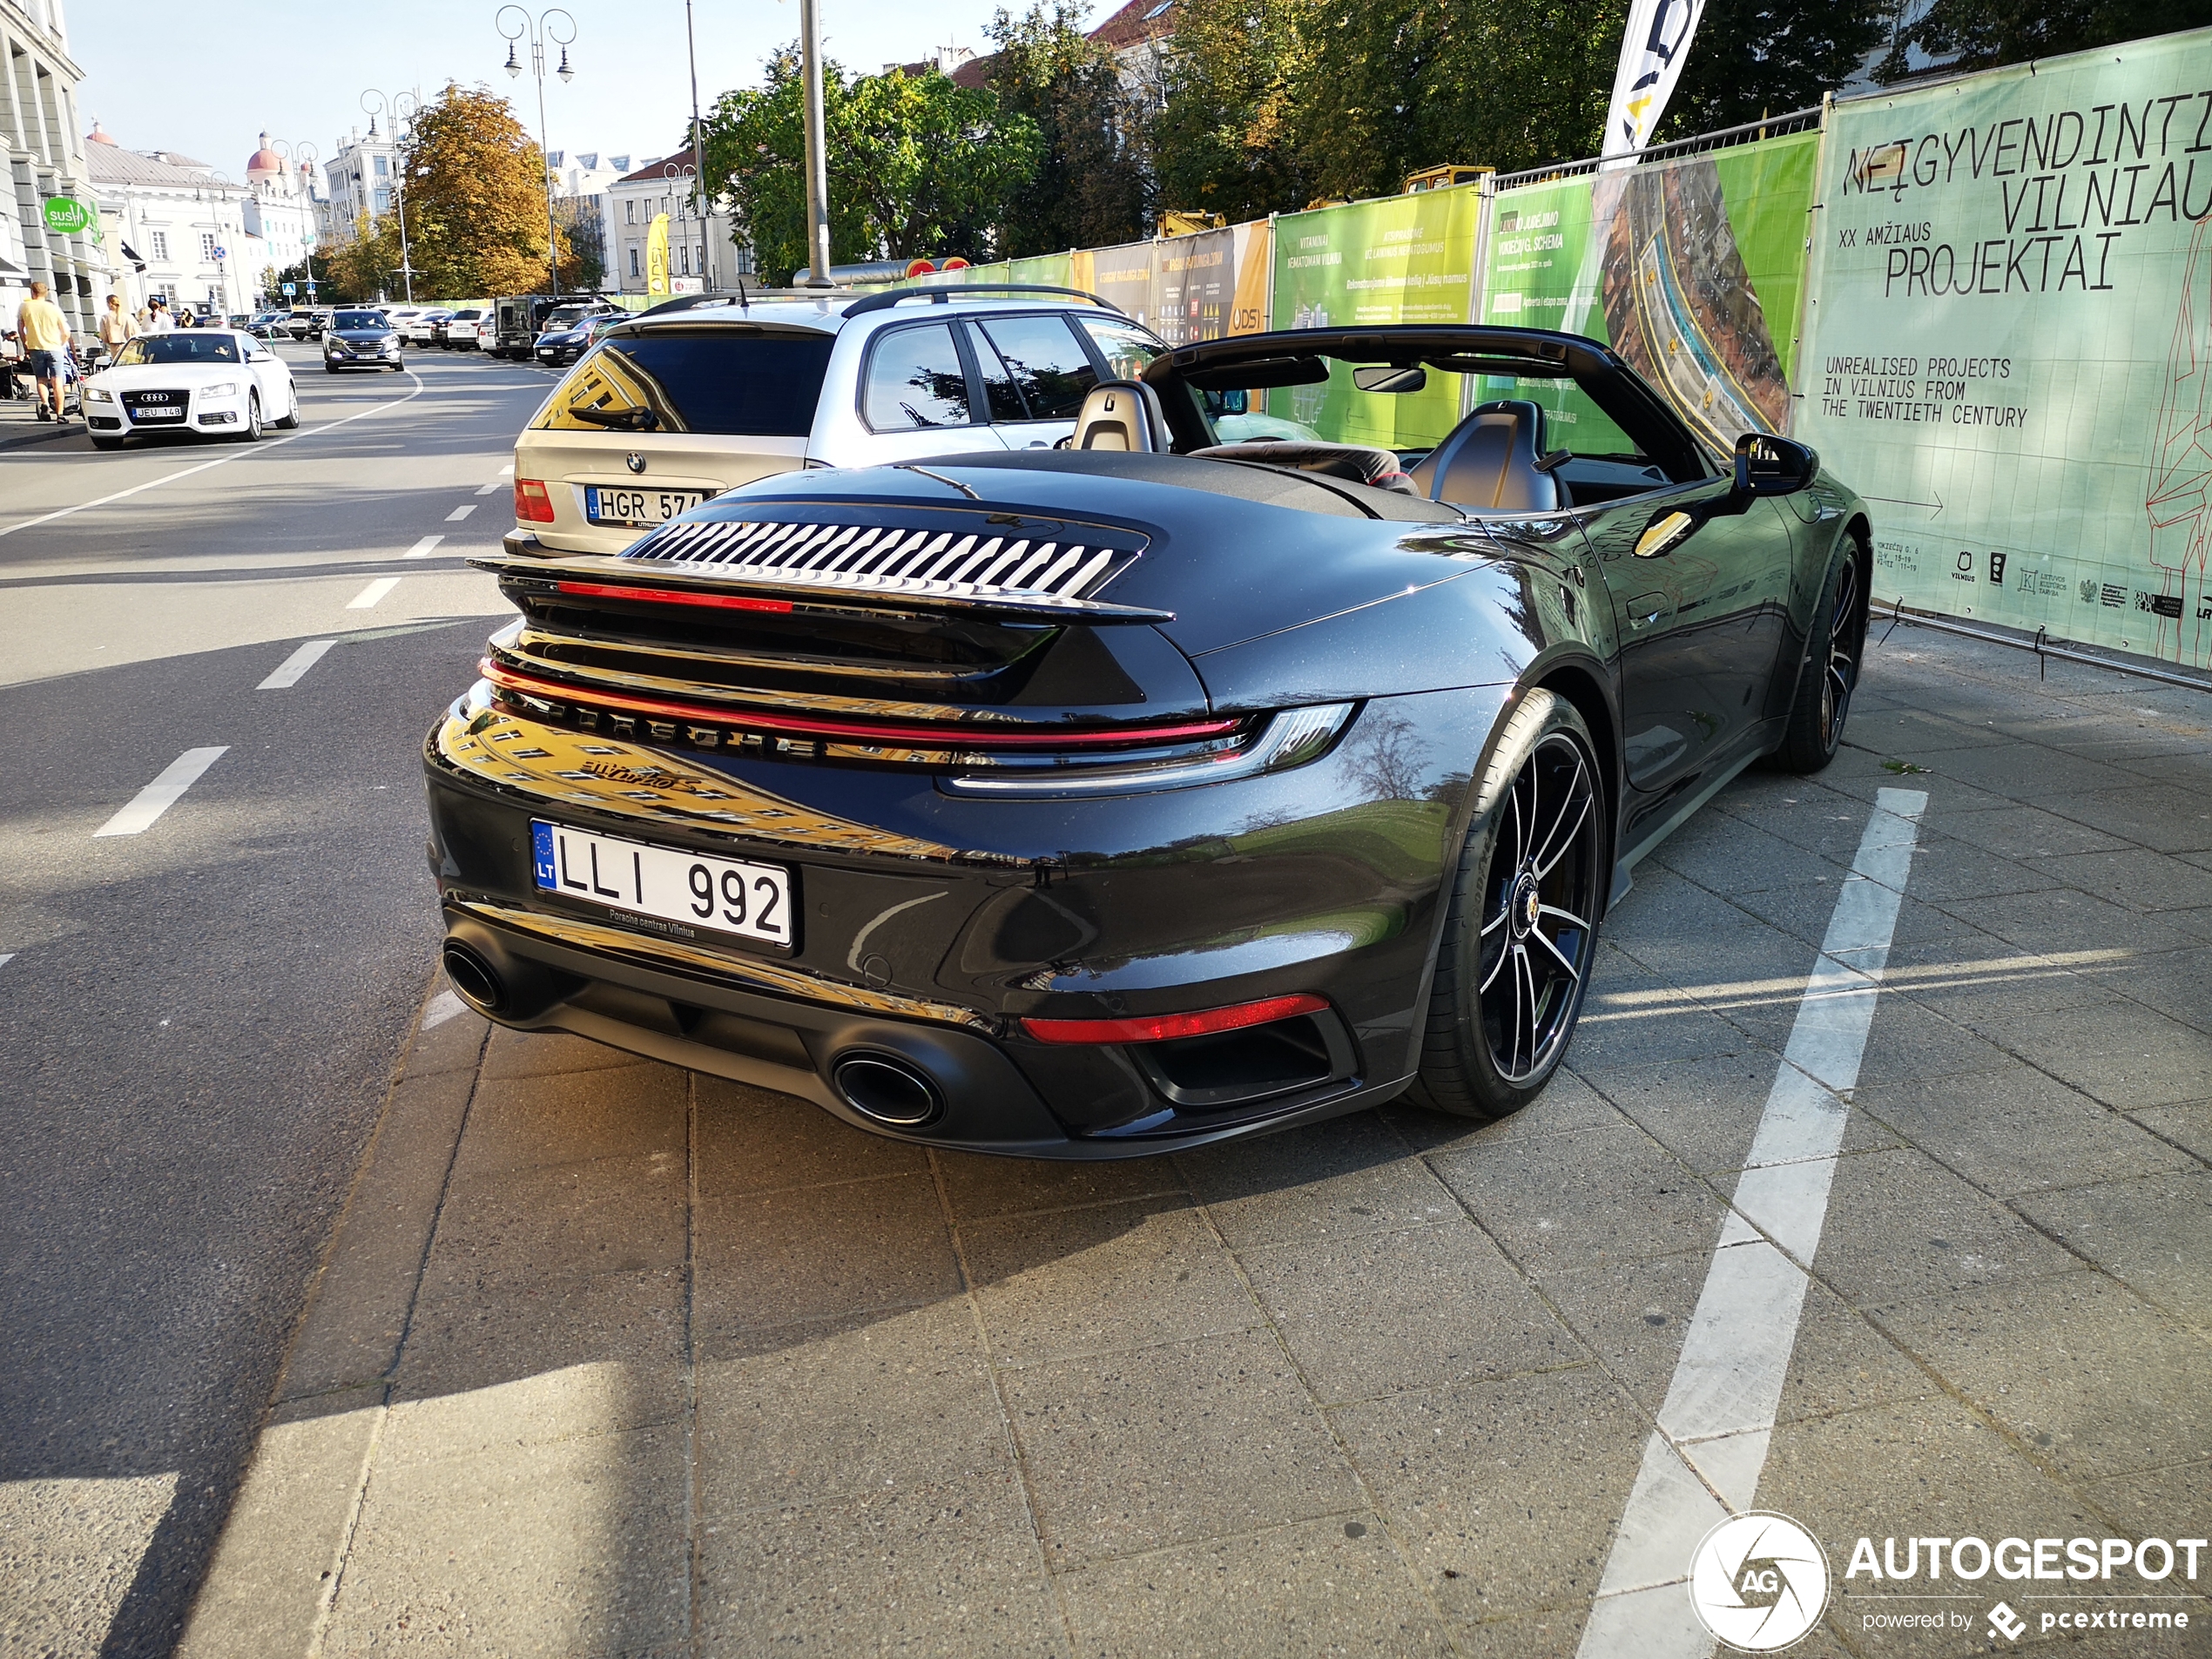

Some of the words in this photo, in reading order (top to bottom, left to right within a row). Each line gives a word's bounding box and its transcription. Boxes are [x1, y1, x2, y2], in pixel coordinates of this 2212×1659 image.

[1844, 90, 2212, 202] NEĮGYVENDINTI
[1299, 233, 1328, 250] VITAMINAI
[1383, 226, 1424, 242] ATSIPRAŠOME
[1533, 233, 1563, 251] SCHEMA
[1838, 228, 1858, 248] XX
[1865, 220, 1932, 246] AMŽIAUS
[1365, 246, 1373, 260] UŽ
[1398, 242, 1445, 258] NEPATOGUMUS
[1885, 232, 2122, 298] PROJEKTAI
[1426, 273, 1442, 287] Jūsų
[1442, 273, 1467, 285] namus
[1826, 356, 1918, 376] UNREALISED
[1927, 358, 2011, 378] PROJECTS
[1824, 377, 1842, 395] IN
[1851, 378, 1915, 398] VILNIUS
[1925, 381, 1966, 401] FROM
[138, 408, 157, 417] JEU
[1822, 398, 1848, 417] THE
[1857, 400, 1943, 422] TWENTIETH
[1952, 404, 2028, 428] CENTURY
[600, 491, 646, 519] HGR
[1894, 554, 1912, 563] 15-19
[1905, 545, 1912, 554] G.
[1900, 563, 1918, 572] 11-19
[1951, 571, 1976, 583] VILNIUS
[2040, 573, 2066, 583] LIETUVOS
[2039, 587, 2060, 597] TARYBA
[549, 701, 820, 760] PORSCHE
[537, 862, 555, 880] LT
[559, 834, 643, 905] LLI
[688, 863, 781, 934] 992
[610, 908, 638, 926] Porsche
[639, 917, 668, 933] centras
[668, 922, 696, 939] Vilnius
